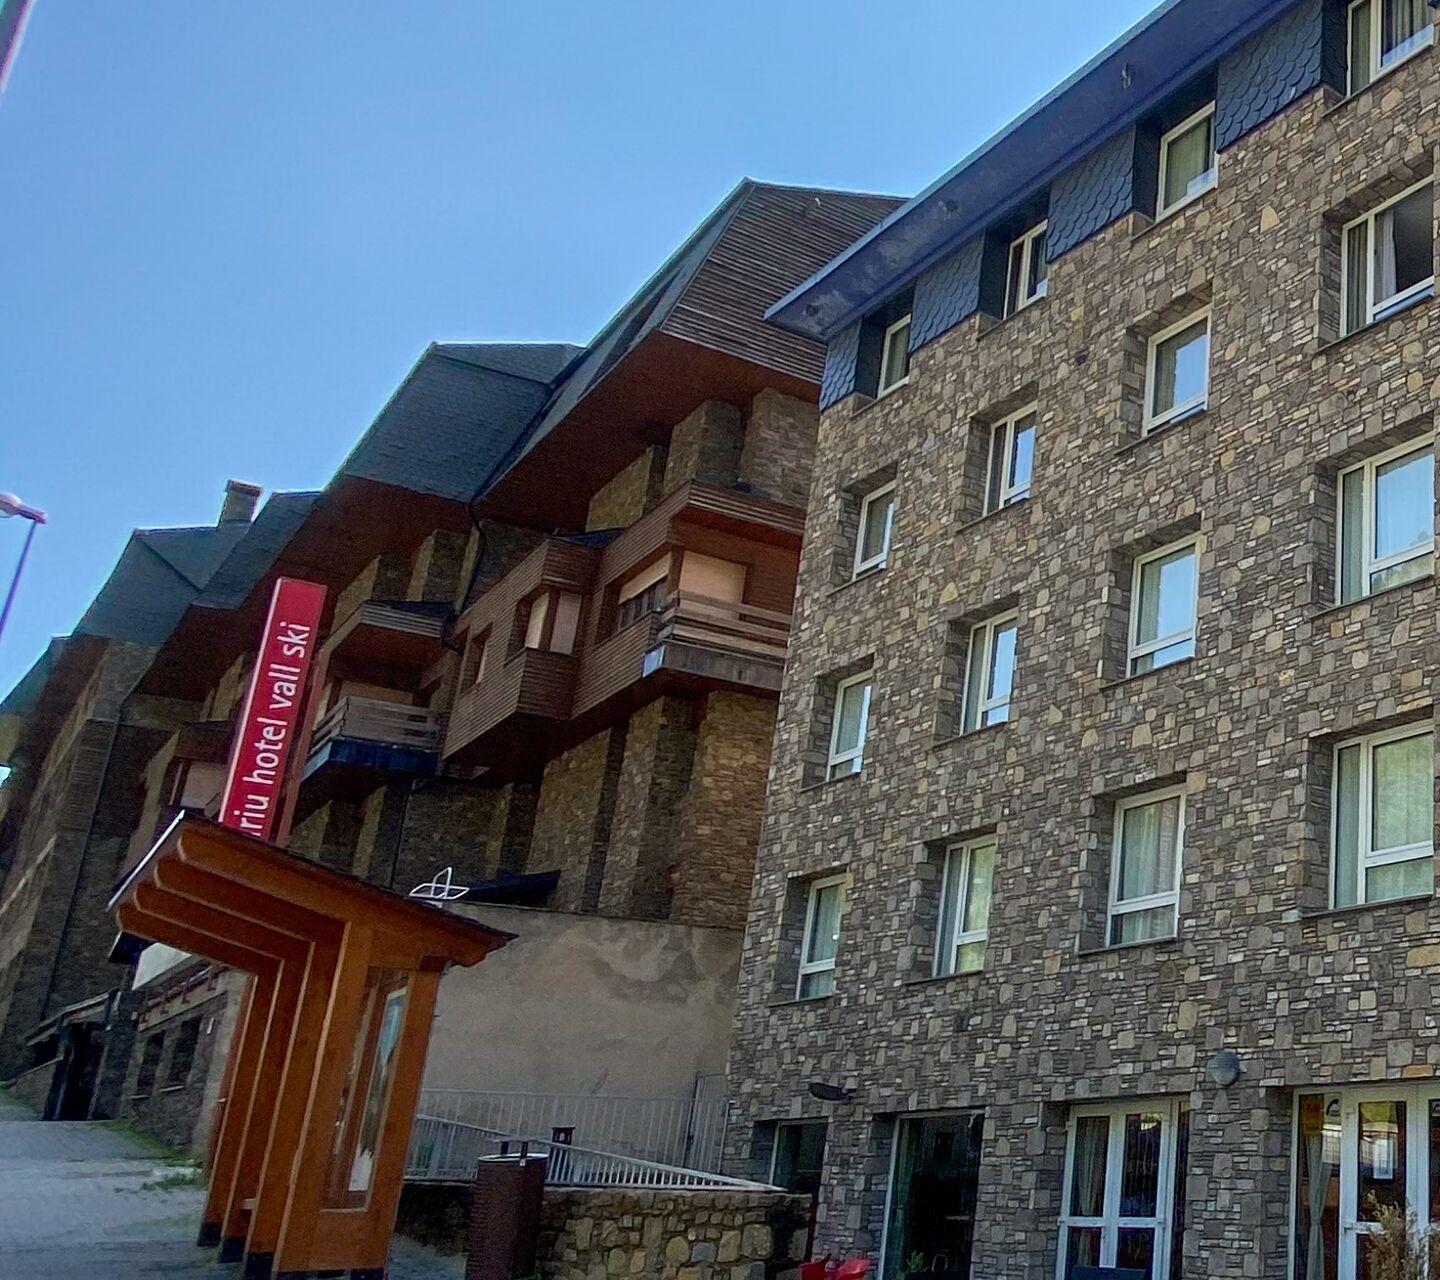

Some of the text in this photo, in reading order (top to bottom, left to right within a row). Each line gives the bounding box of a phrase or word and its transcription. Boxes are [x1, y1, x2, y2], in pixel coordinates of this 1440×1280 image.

[277, 621, 311, 659] ski
[268, 663, 301, 710] vall
[242, 717, 288, 785] hotel
